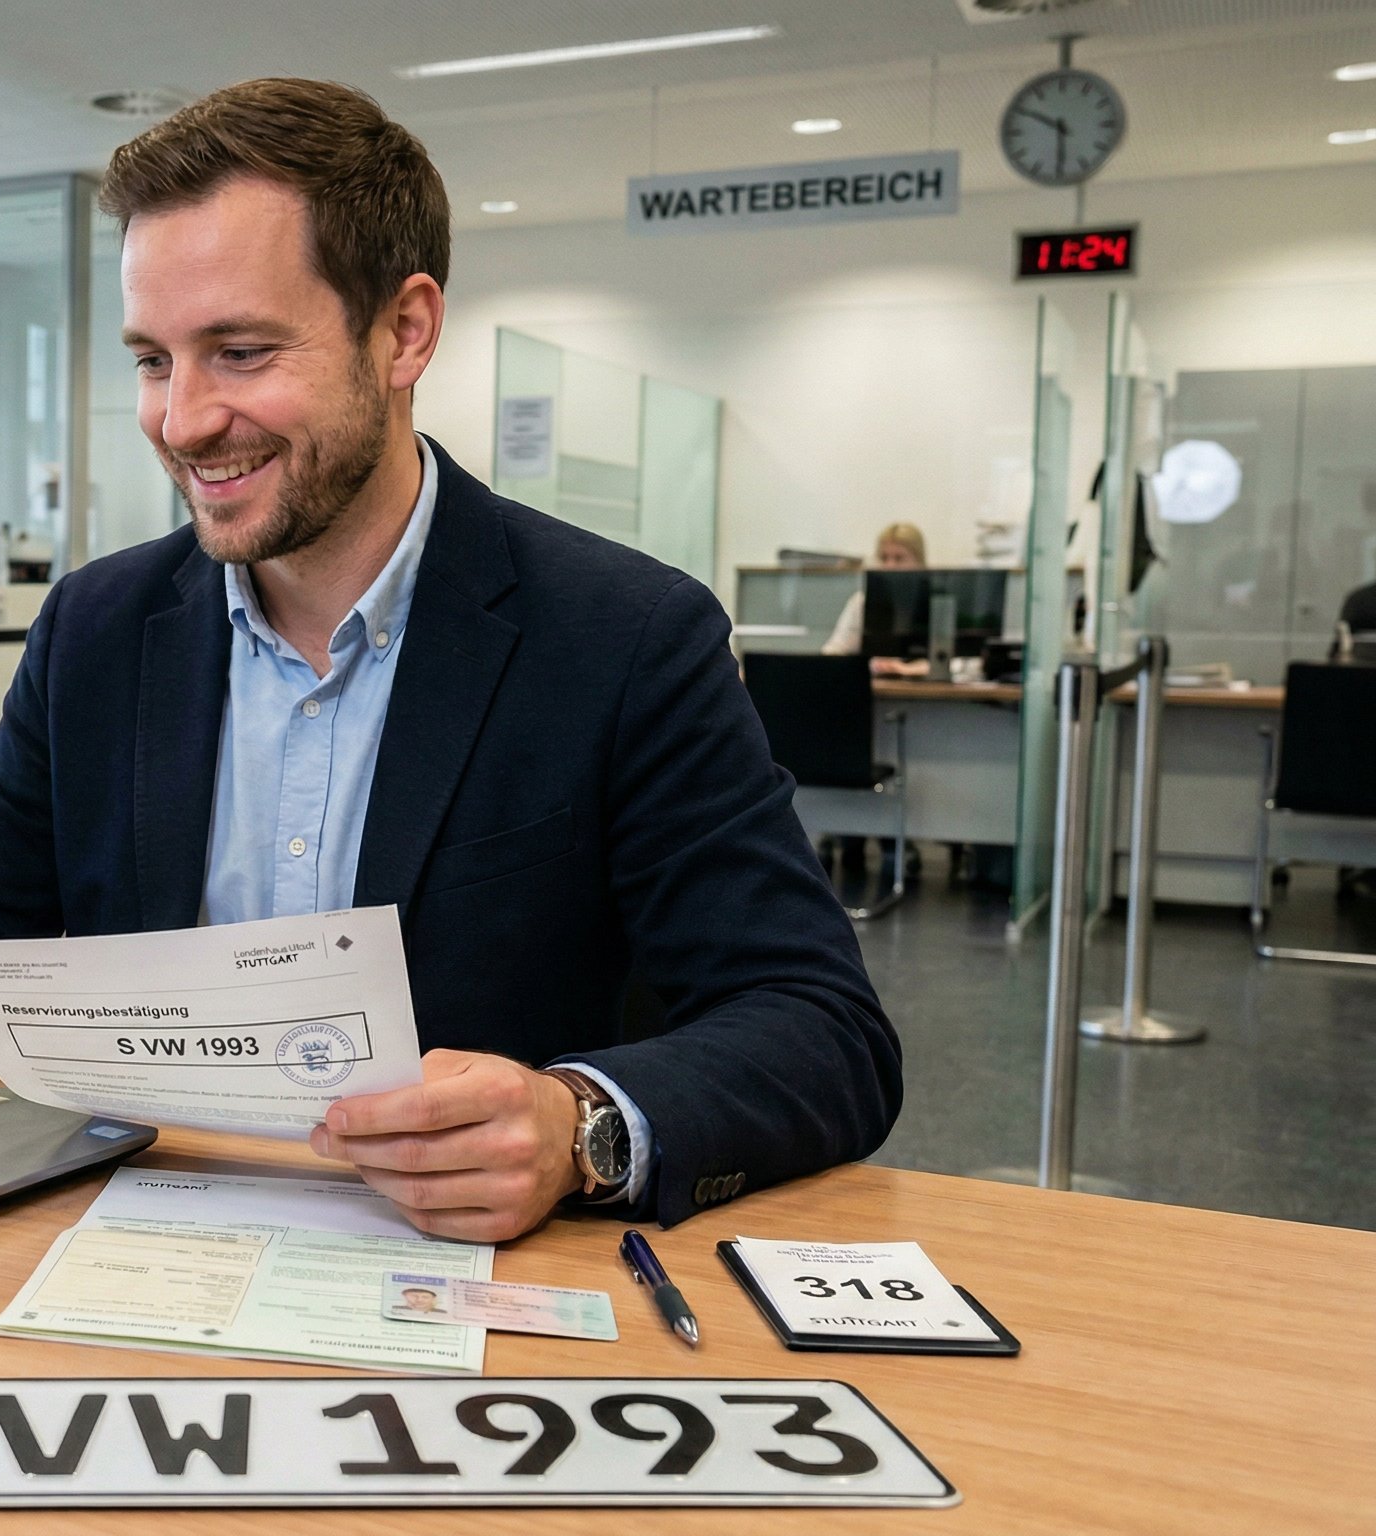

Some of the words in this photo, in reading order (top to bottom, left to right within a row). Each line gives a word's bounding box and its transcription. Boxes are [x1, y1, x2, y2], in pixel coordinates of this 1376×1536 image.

[639, 168, 943, 221] WARTEBEREICH
[1037, 234, 1127, 270] 11:24
[235, 953, 299, 970] STUTTGART
[1, 1004, 189, 1020] Reservierungsbestätigung
[116, 1038, 136, 1056] S
[140, 1038, 186, 1056] VW
[195, 1036, 260, 1057] 1993
[793, 1275, 925, 1302] 318
[809, 1316, 918, 1328] STUTTGART
[321, 1392, 879, 1477] 1993
